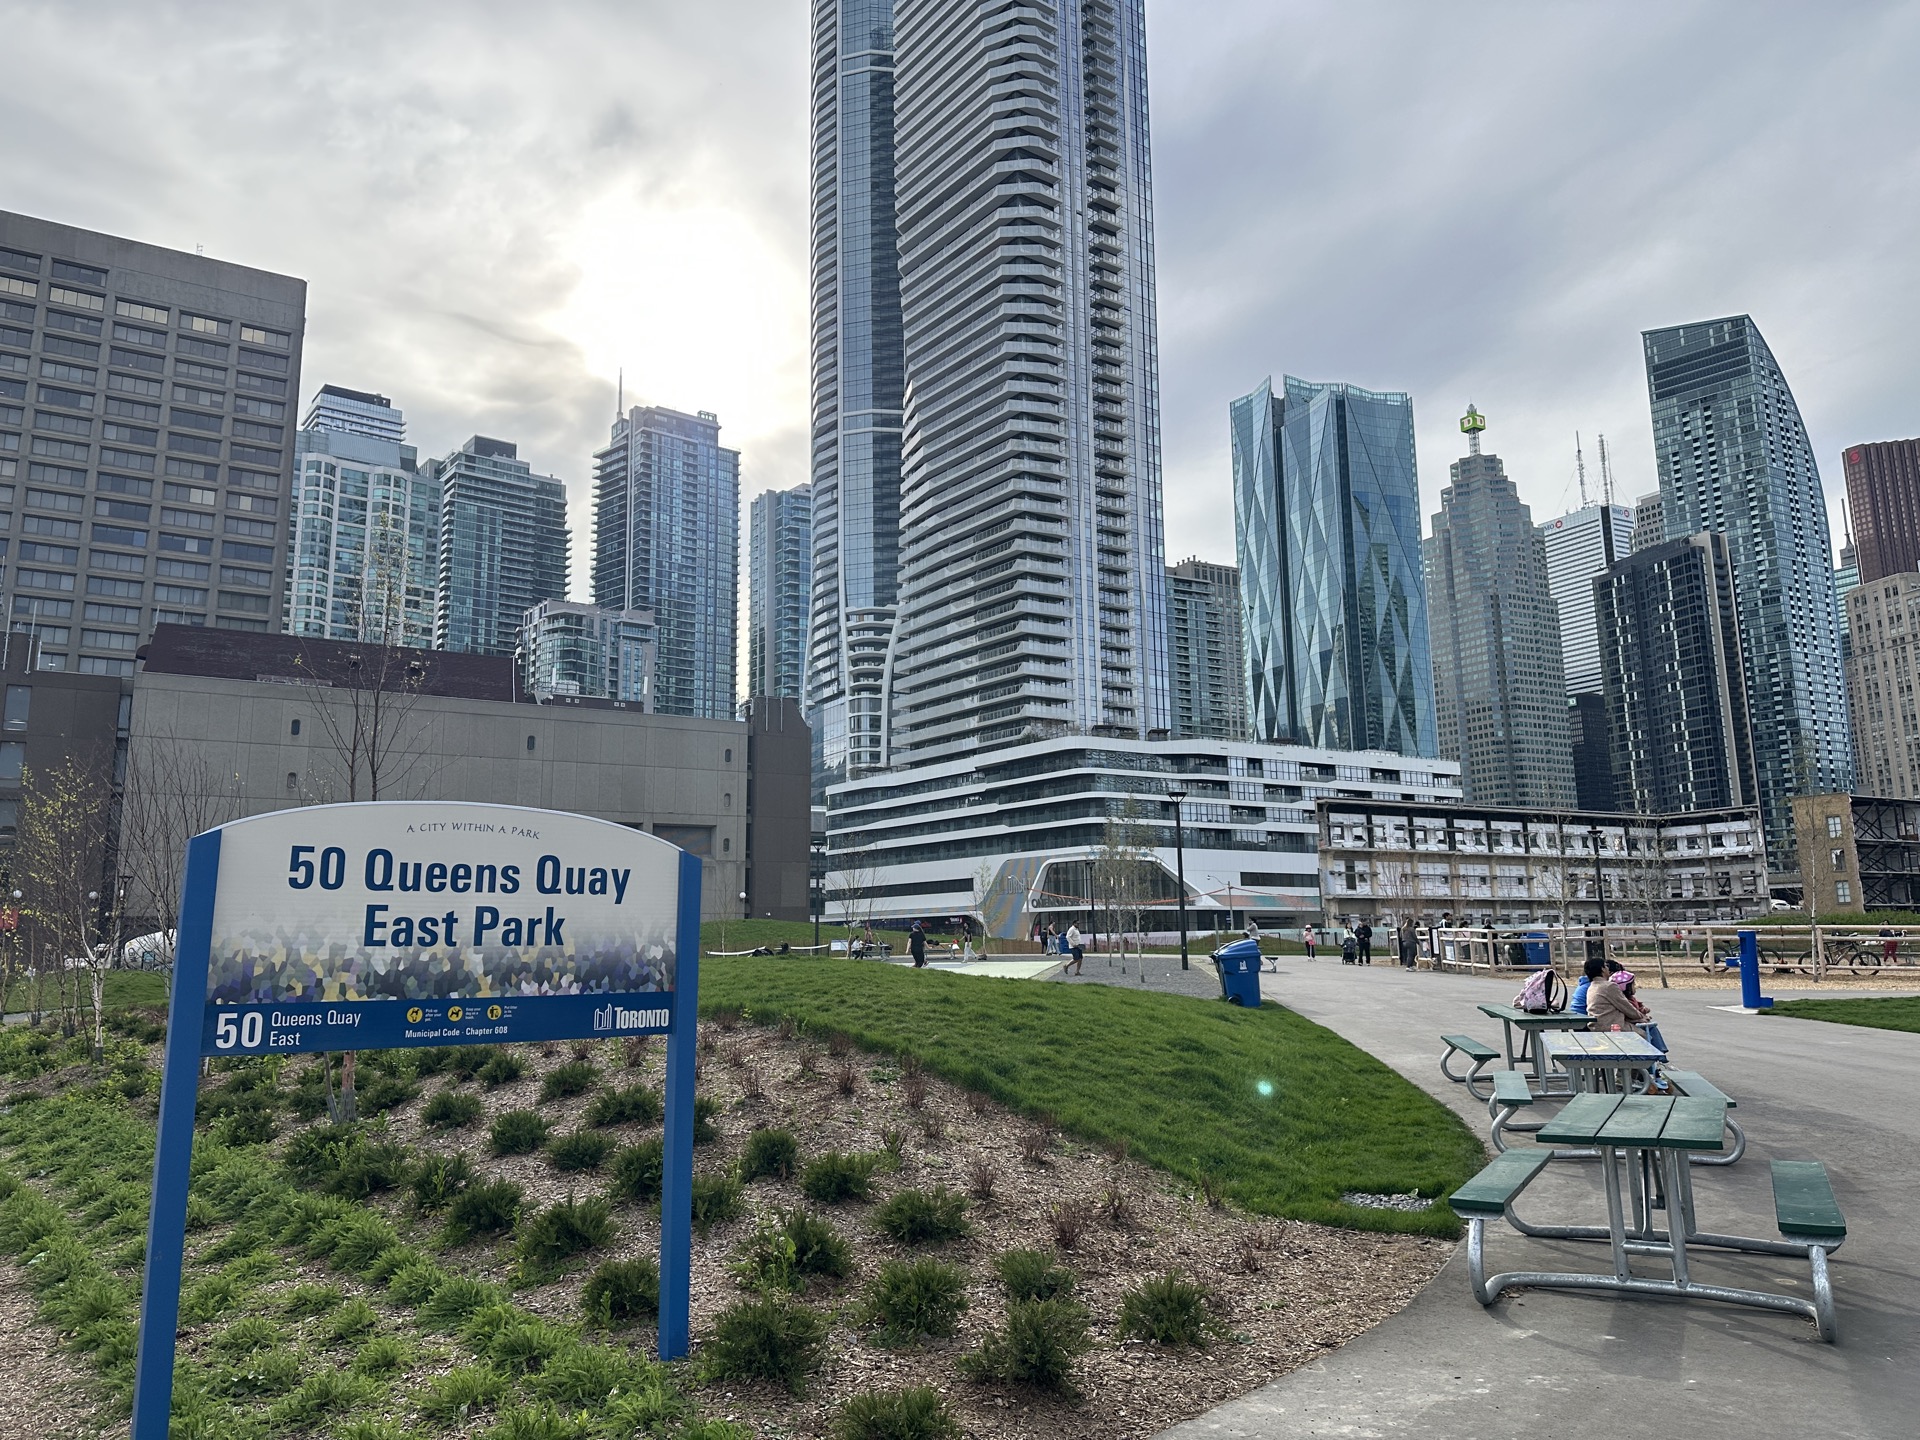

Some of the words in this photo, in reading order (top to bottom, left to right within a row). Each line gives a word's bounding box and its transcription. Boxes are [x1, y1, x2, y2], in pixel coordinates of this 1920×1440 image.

[1543, 523, 1555, 531] MO
[406, 824, 415, 833] A
[419, 822, 447, 832] CITY
[451, 822, 495, 833] WITHIN
[498, 825, 507, 834] A
[511, 826, 540, 840] PARK
[288, 845, 346, 891] 50
[364, 848, 521, 894] Queens
[536, 854, 631, 905] Quay
[363, 904, 459, 947] East
[473, 905, 566, 947] Park
[271, 1011, 322, 1027] Queens
[327, 1009, 361, 1028] Quay
[614, 1006, 670, 1030] TORONTO
[215, 1011, 263, 1049] 50
[269, 1031, 301, 1047] East
[405, 1029, 441, 1038] Municipal
[442, 1028, 460, 1037] Code
[465, 1027, 493, 1037] Chapter
[494, 1025, 508, 1035] 608
